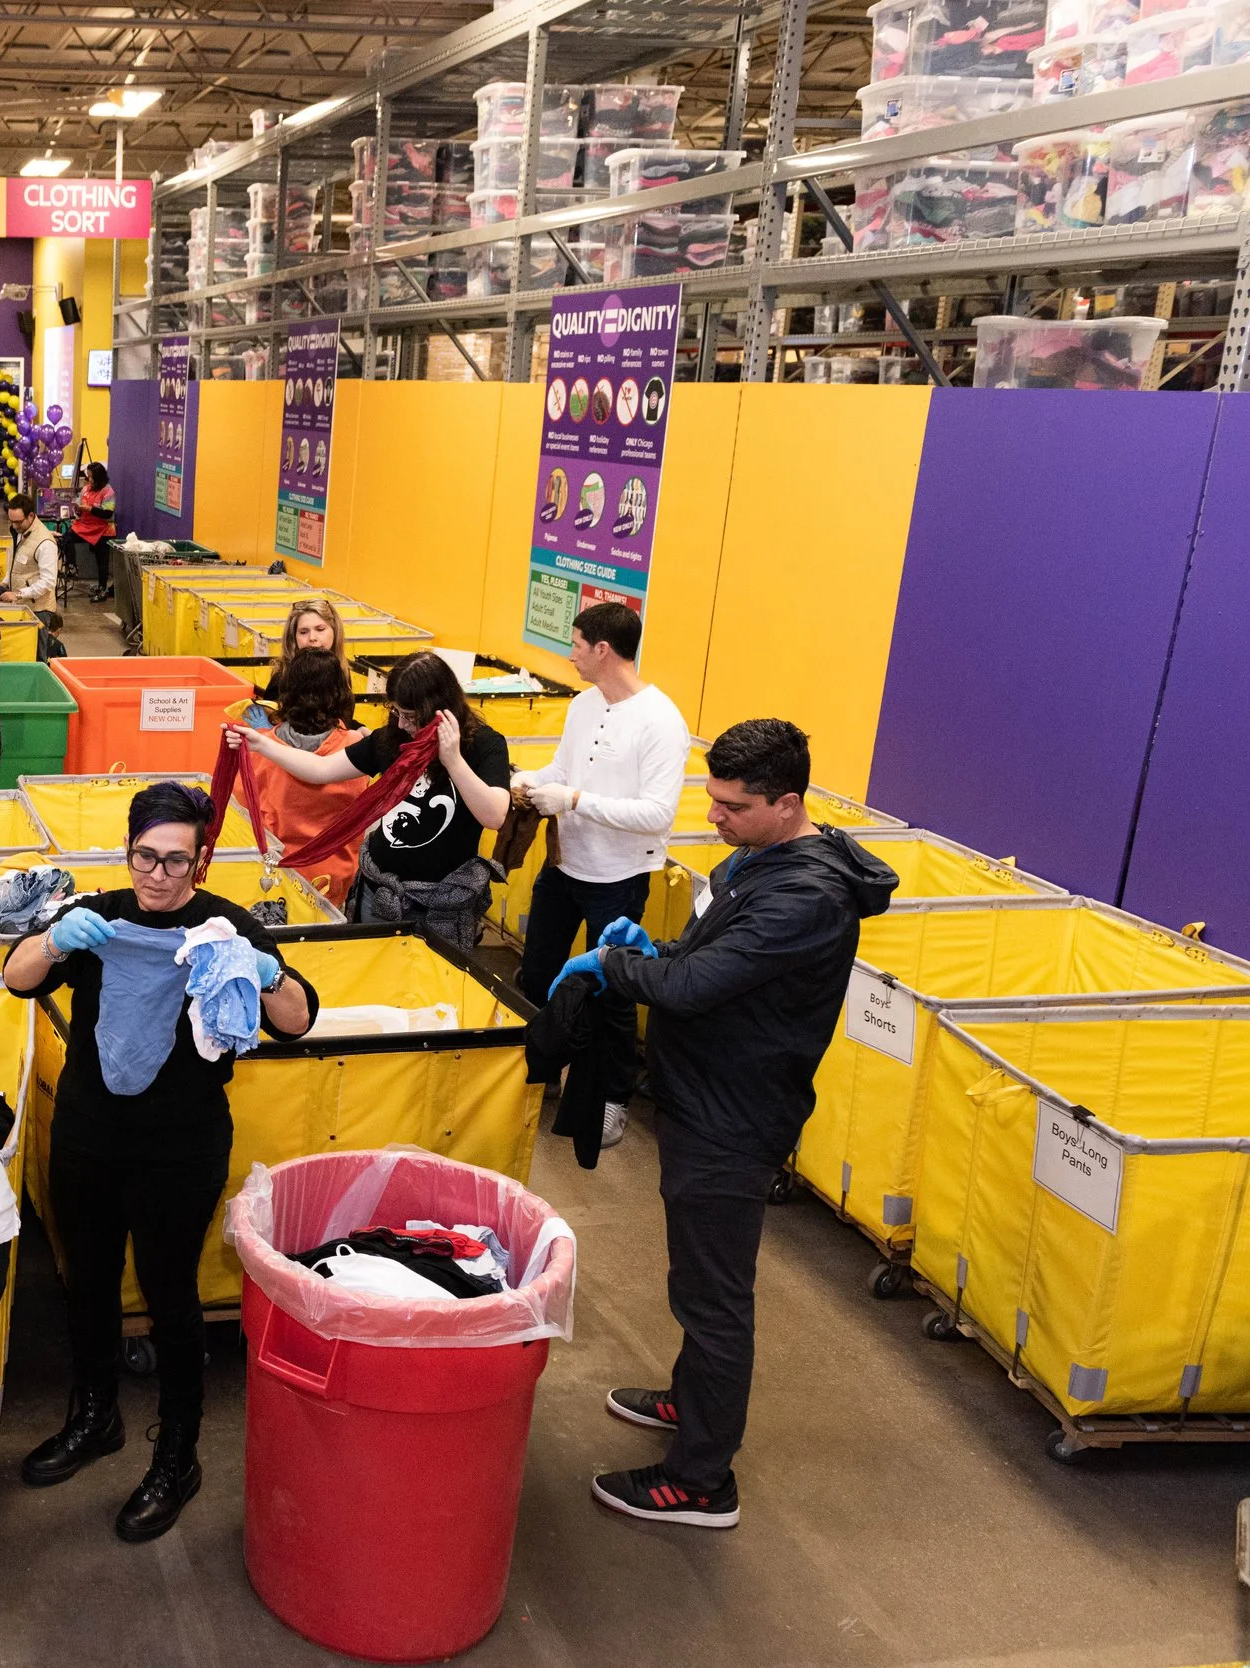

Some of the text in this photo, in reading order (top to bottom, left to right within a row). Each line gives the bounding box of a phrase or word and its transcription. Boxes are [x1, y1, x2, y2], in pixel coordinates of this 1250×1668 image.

[23, 184, 137, 209] CLOTHING
[51, 210, 110, 233] SORT
[577, 355, 585, 363] NO
[597, 354, 604, 362] NO
[622, 348, 630, 357] NO
[650, 347, 658, 356] NO
[625, 437, 654, 449] ONLY Chicago
[610, 547, 622, 557] Socks
[555, 555, 616, 580] CLOTHING SIZE GUIDE
[540, 589, 552, 600] Youth
[552, 592, 563, 604] Sizes
[594, 588, 604, 601] NO,
[531, 602, 555, 617] Adult Small
[530, 616, 559, 633] Adult Medium
[154, 706, 182, 714] Supplies
[863, 1010, 896, 1034] Shorts
[1061, 1148, 1092, 1177] Pants
[1081, 1140, 1108, 1170] Long
